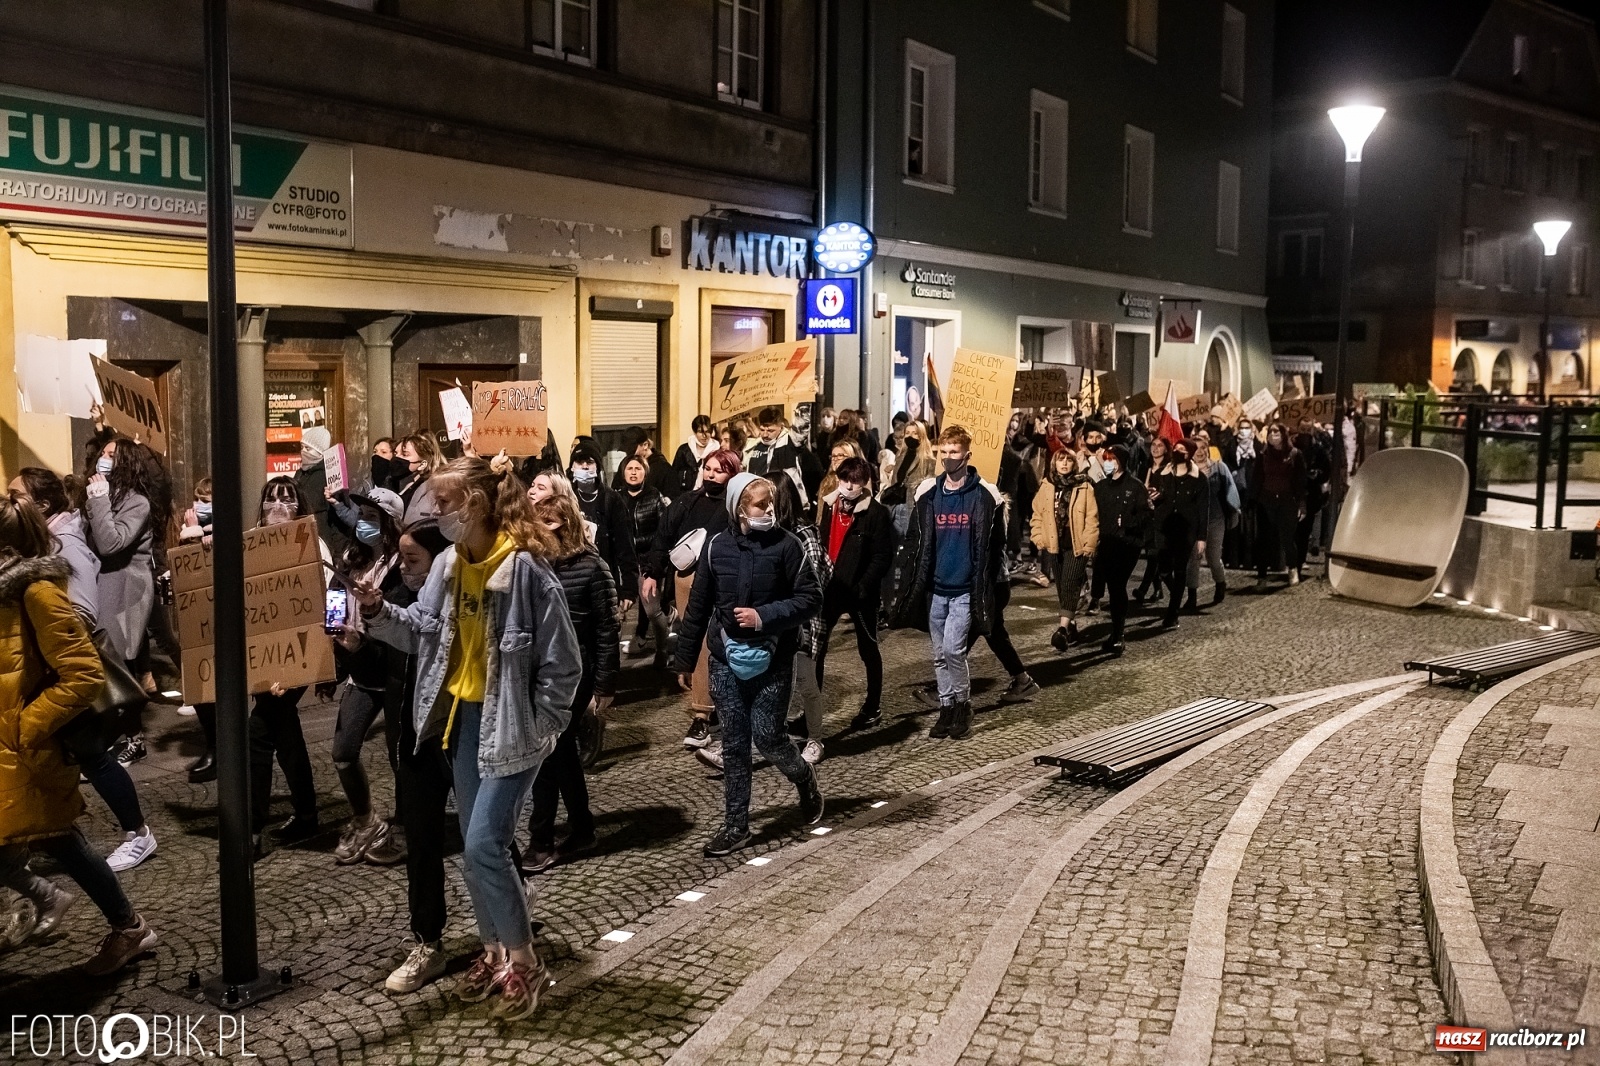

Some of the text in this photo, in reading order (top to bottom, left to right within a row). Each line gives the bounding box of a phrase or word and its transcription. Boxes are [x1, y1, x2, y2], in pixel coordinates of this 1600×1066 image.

[0, 108, 241, 187] FUJIFIL
[289, 185, 340, 204] STUDIO
[112, 190, 256, 221] FOTOGRAFNE
[272, 202, 346, 221] CYFR@FOTO
[267, 222, 347, 238] www.fotokaminski.pl
[688, 218, 807, 279] KANTOR
[826, 240, 861, 251] KANTOR
[916, 267, 956, 286] Santander
[915, 285, 956, 299] Consumer Bank
[808, 317, 851, 329] Monetia
[970, 352, 1005, 369] CHCEMY
[988, 371, 998, 382] Z
[97, 372, 162, 433] WOLNA
[991, 403, 1005, 417] NIE
[1313, 399, 1335, 416] OFF
[946, 407, 954, 418] Z
[439, 434, 448, 442] LG
[273, 461, 291, 472] VHS
[179, 591, 197, 611] ZA
[289, 597, 313, 616] DO
